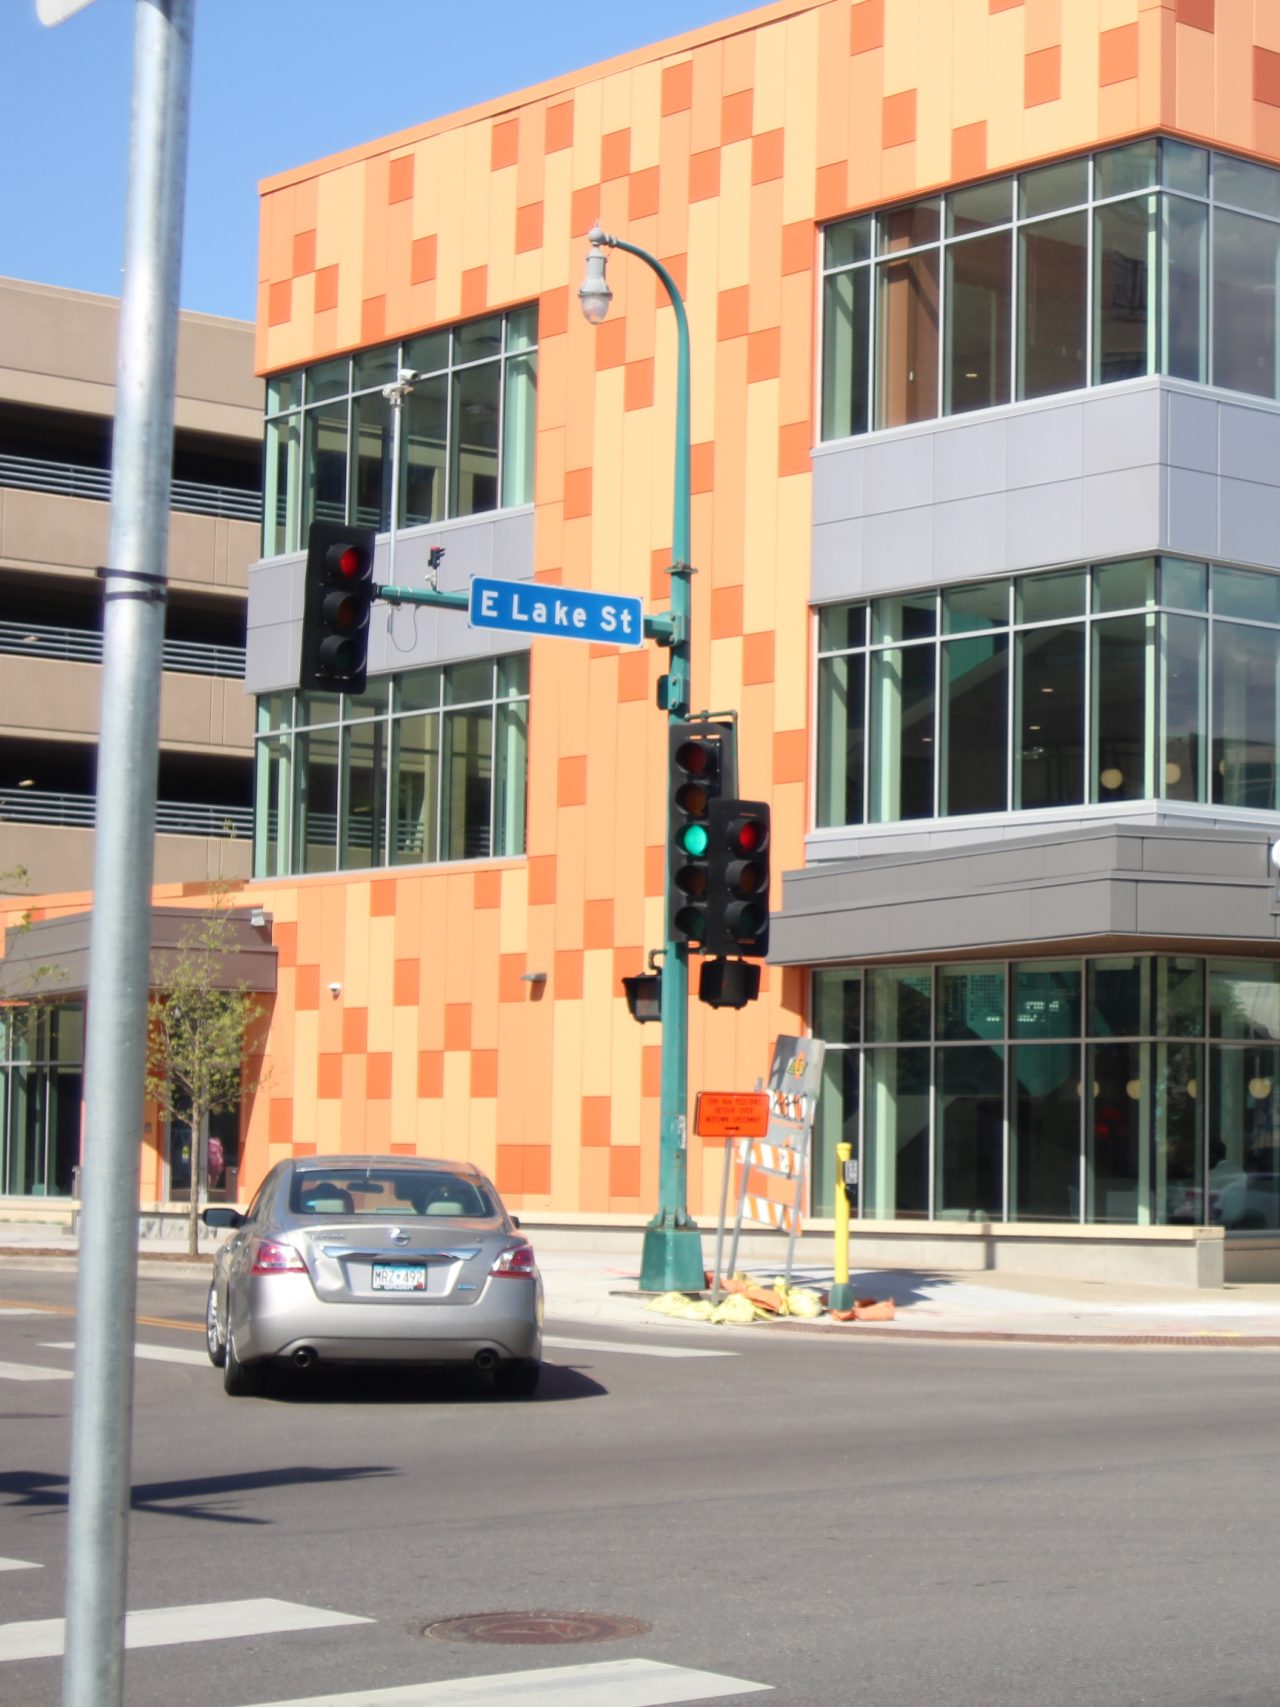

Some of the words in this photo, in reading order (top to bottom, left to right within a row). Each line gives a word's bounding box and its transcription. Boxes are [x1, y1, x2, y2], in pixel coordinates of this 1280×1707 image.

[481, 590, 499, 617] E
[512, 593, 587, 628] Lake
[600, 605, 632, 634] St
